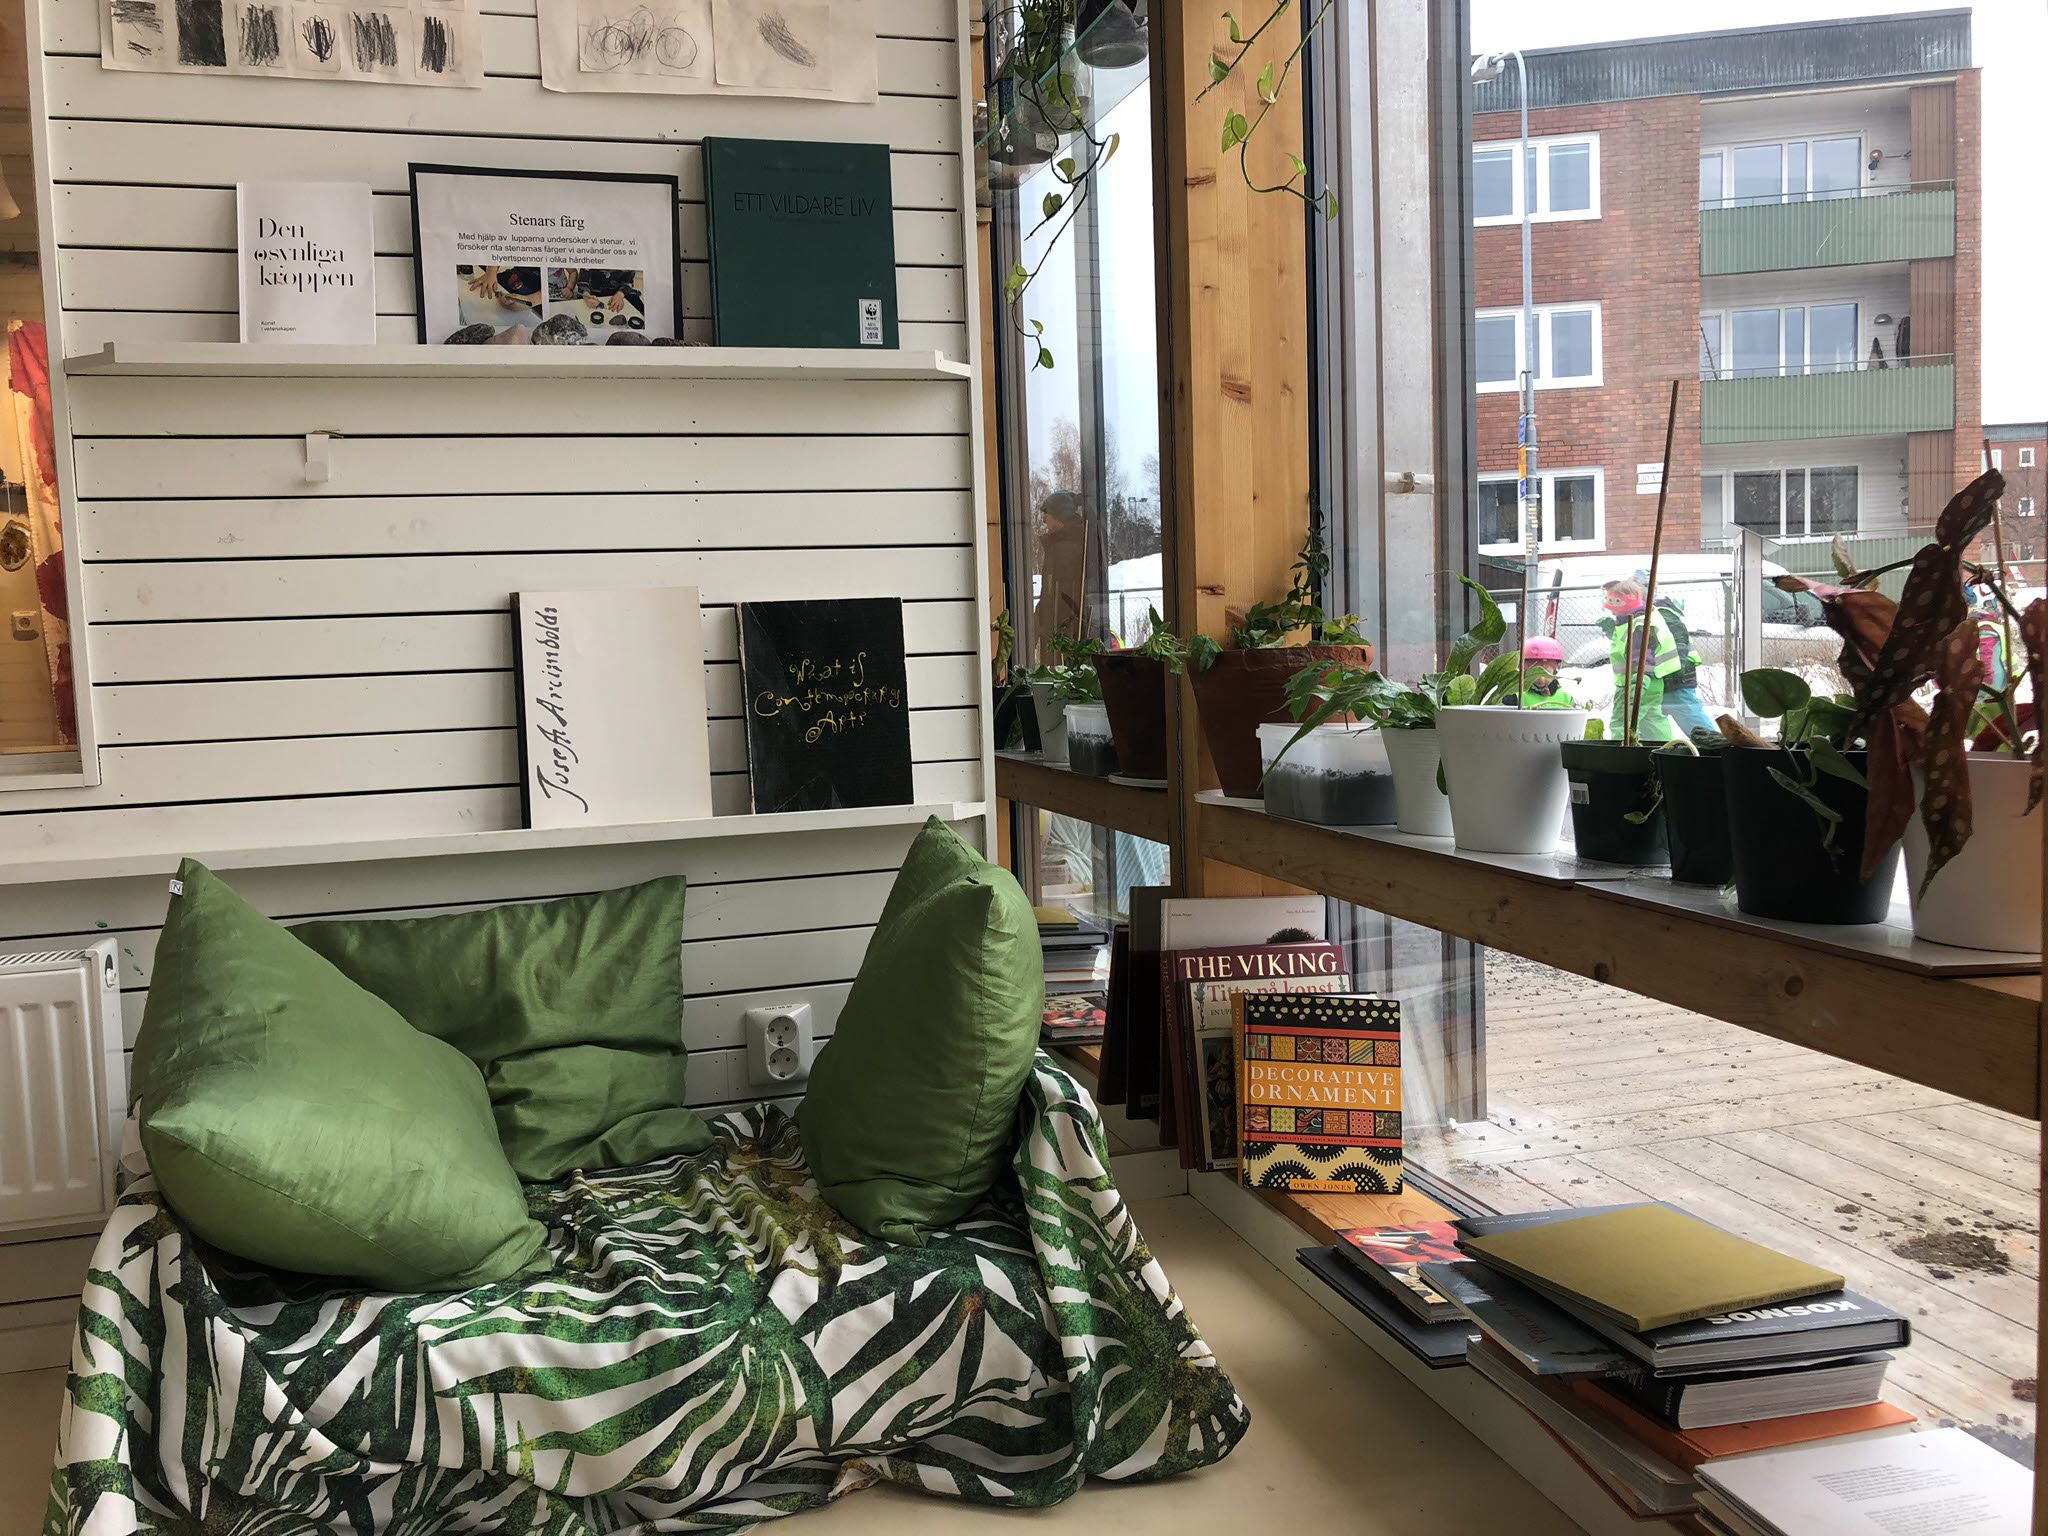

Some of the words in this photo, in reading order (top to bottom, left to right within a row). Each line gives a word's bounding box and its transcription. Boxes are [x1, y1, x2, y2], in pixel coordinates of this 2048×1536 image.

[734, 192, 765, 211] ETT
[770, 194, 844, 216] VILDARE
[850, 198, 876, 217] LIV
[259, 218, 304, 238] Den
[509, 213, 556, 227] Stenars
[560, 215, 585, 231] färg
[457, 243, 488, 251] försöker
[576, 246, 612, 255] använder
[458, 233, 475, 241] Med
[477, 233, 496, 242] hjälp
[511, 234, 545, 243] lupparna
[546, 236, 589, 244] undersöker
[491, 254, 544, 263] blyertspennor
[260, 265, 354, 293] kroppen
[789, 658, 842, 685] What
[849, 651, 867, 688] is
[1179, 955, 1233, 979] THE
[1236, 952, 1338, 977] VIKING
[1250, 1066, 1394, 1087] DECORATIVE
[1249, 1083, 1396, 1105] ORNAMENT
[1323, 1183, 1352, 1191] JONES
[1704, 1300, 1863, 1325] KOSMOS
